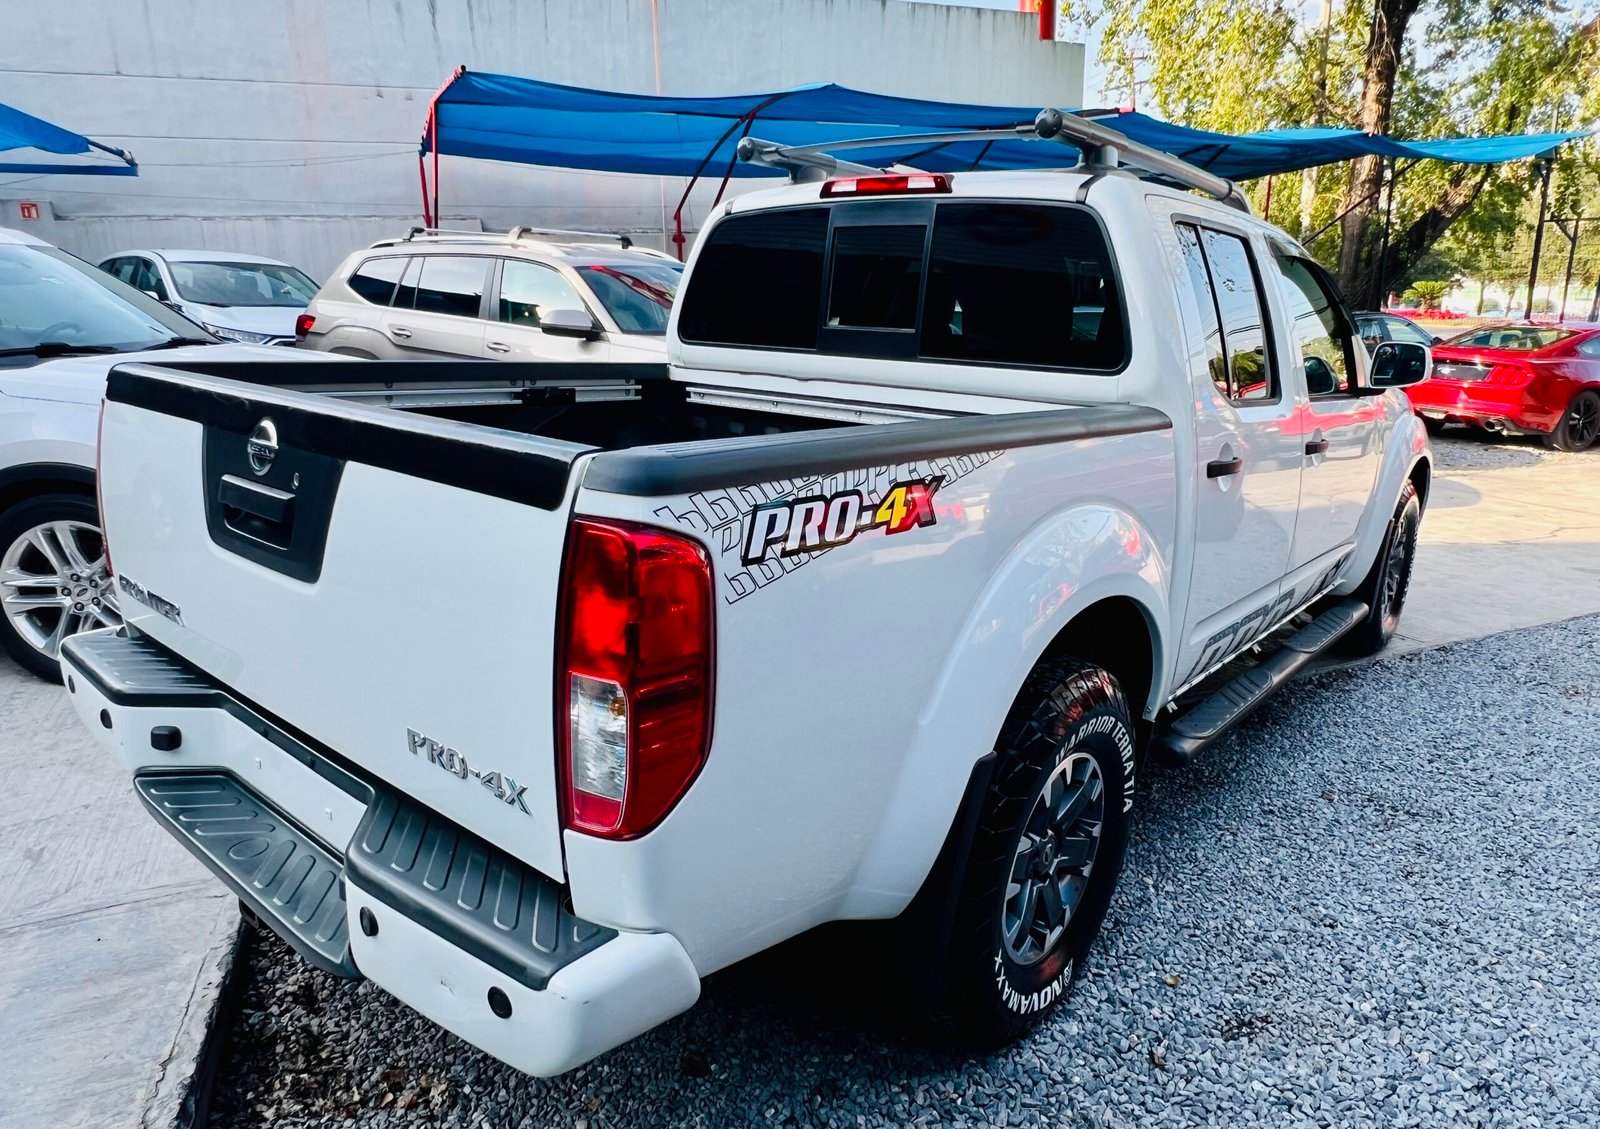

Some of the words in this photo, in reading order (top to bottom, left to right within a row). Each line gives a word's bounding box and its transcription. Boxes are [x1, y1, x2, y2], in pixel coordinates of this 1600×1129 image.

[742, 476, 946, 566] PRO-4X
[406, 727, 532, 816] PRO-4X
[1055, 715, 1116, 766] WARRIOR
[1111, 721, 1136, 777] TERRA
[994, 948, 1063, 1015] NOVAMAXX
